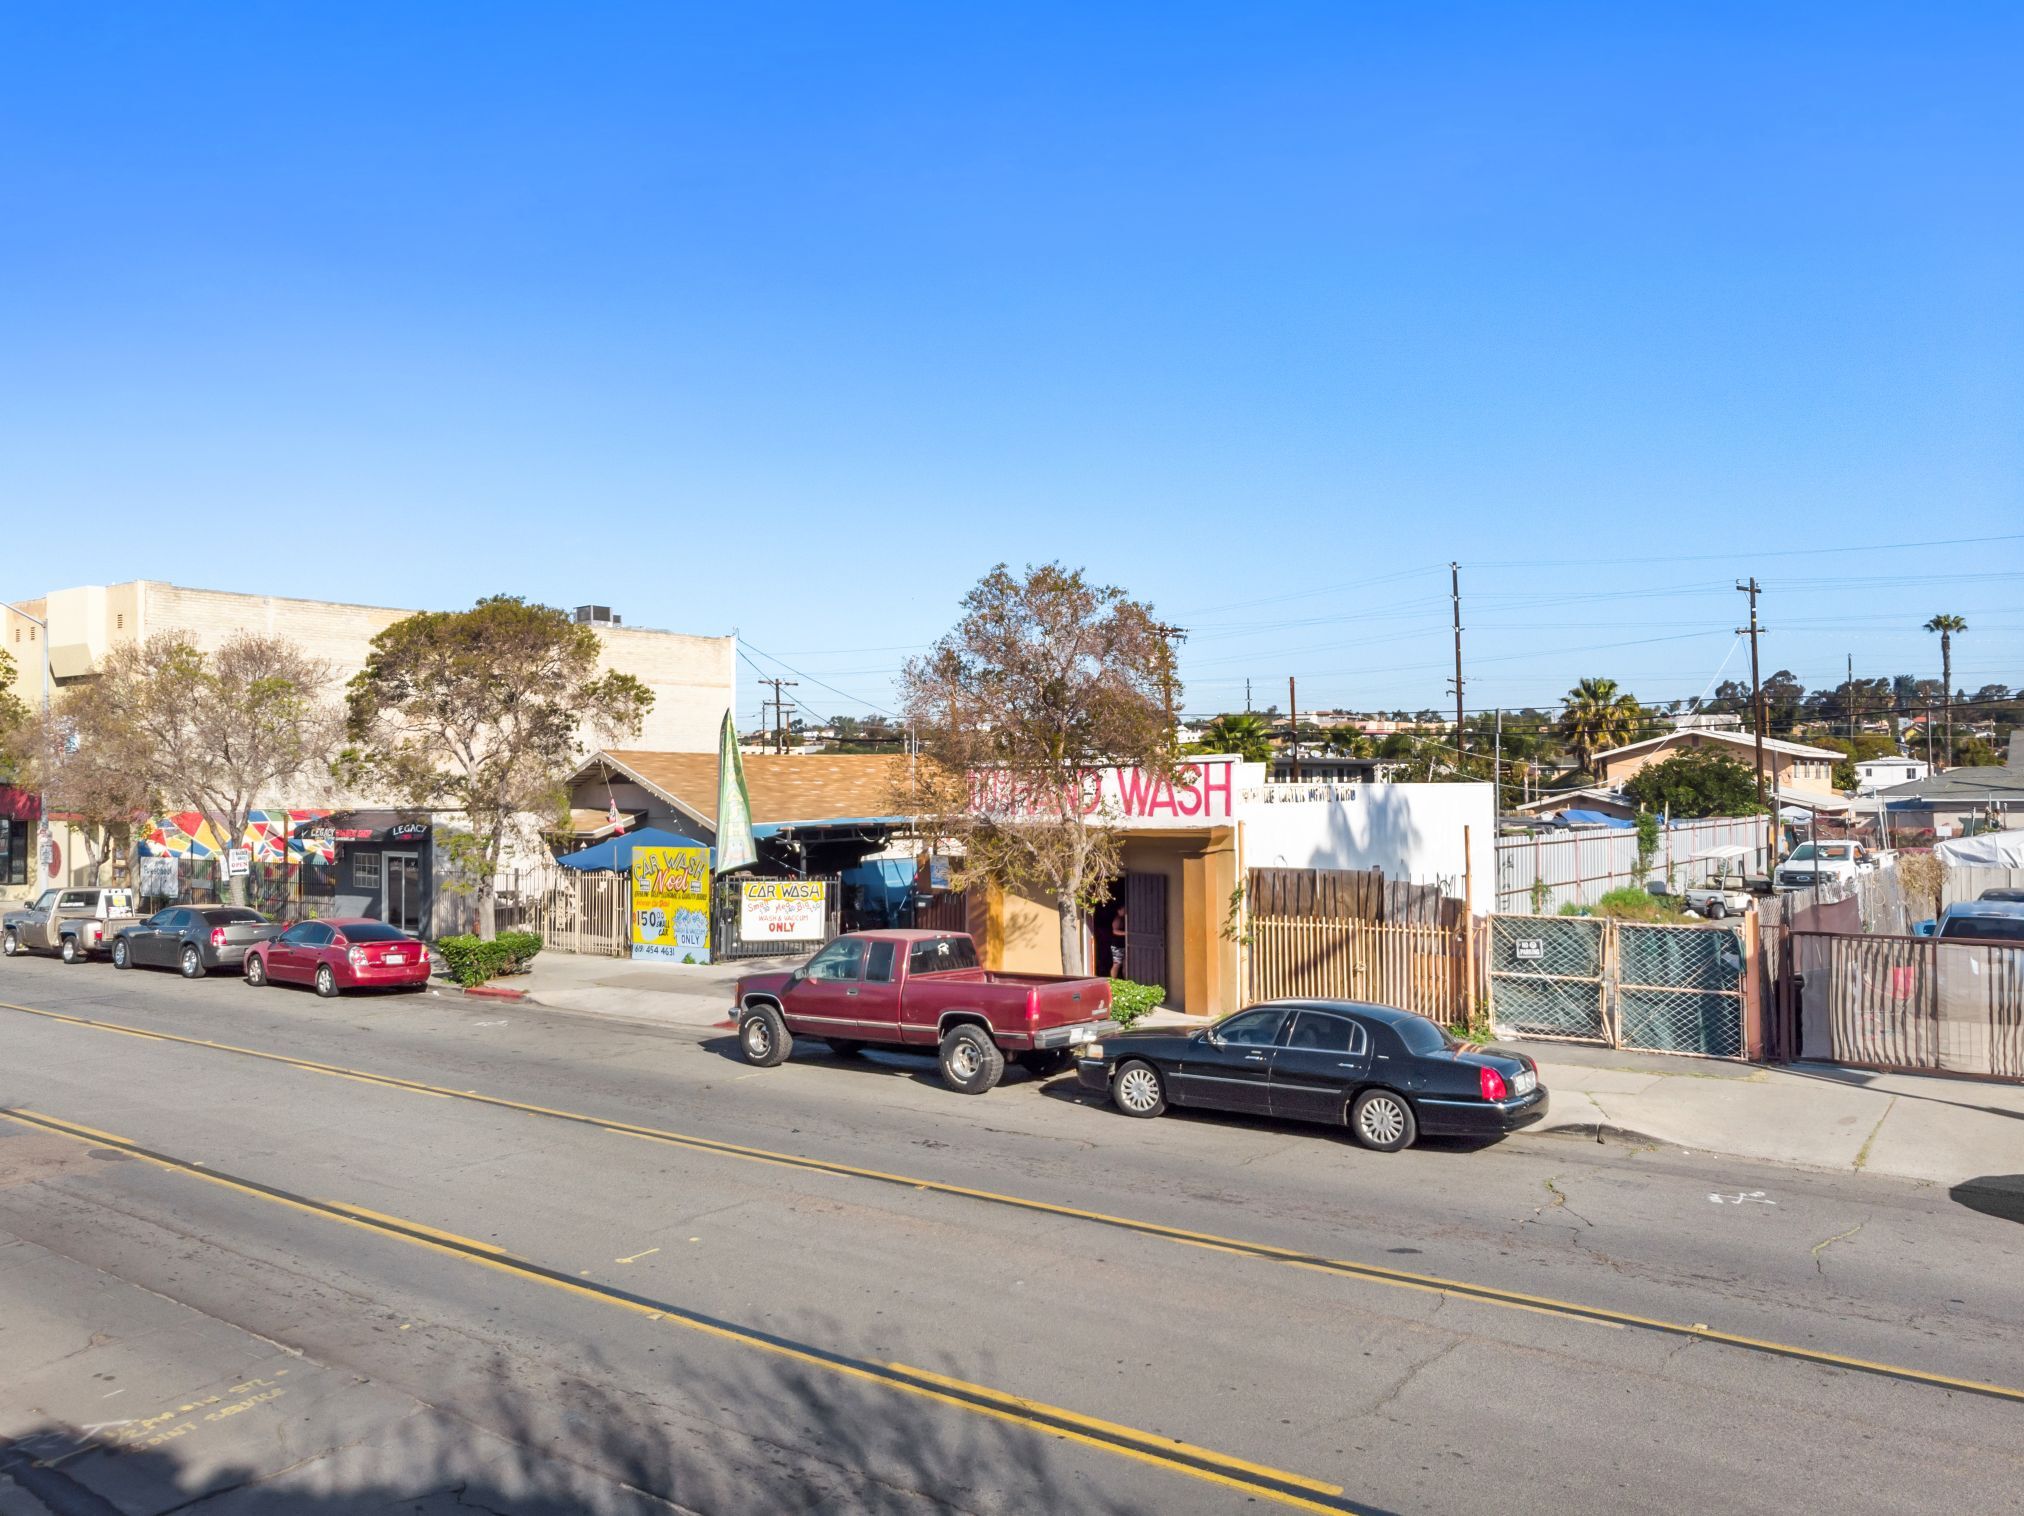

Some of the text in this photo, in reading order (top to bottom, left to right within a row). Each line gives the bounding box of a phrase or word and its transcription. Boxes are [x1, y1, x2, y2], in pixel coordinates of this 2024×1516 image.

[1117, 761, 1231, 818] WASH
[310, 827, 336, 837] LEGACY
[393, 824, 427, 836] LEGACY
[634, 851, 706, 882] CAR WASH
[652, 868, 690, 894] Noel
[748, 885, 820, 898] CAR WASH
[658, 929, 669, 937] CAR
[768, 922, 795, 933] ONLY
[681, 934, 700, 945] ONLY
[1521, 941, 1529, 949] NO
[645, 946, 659, 955] 454
[660, 947, 675, 956] 4631
